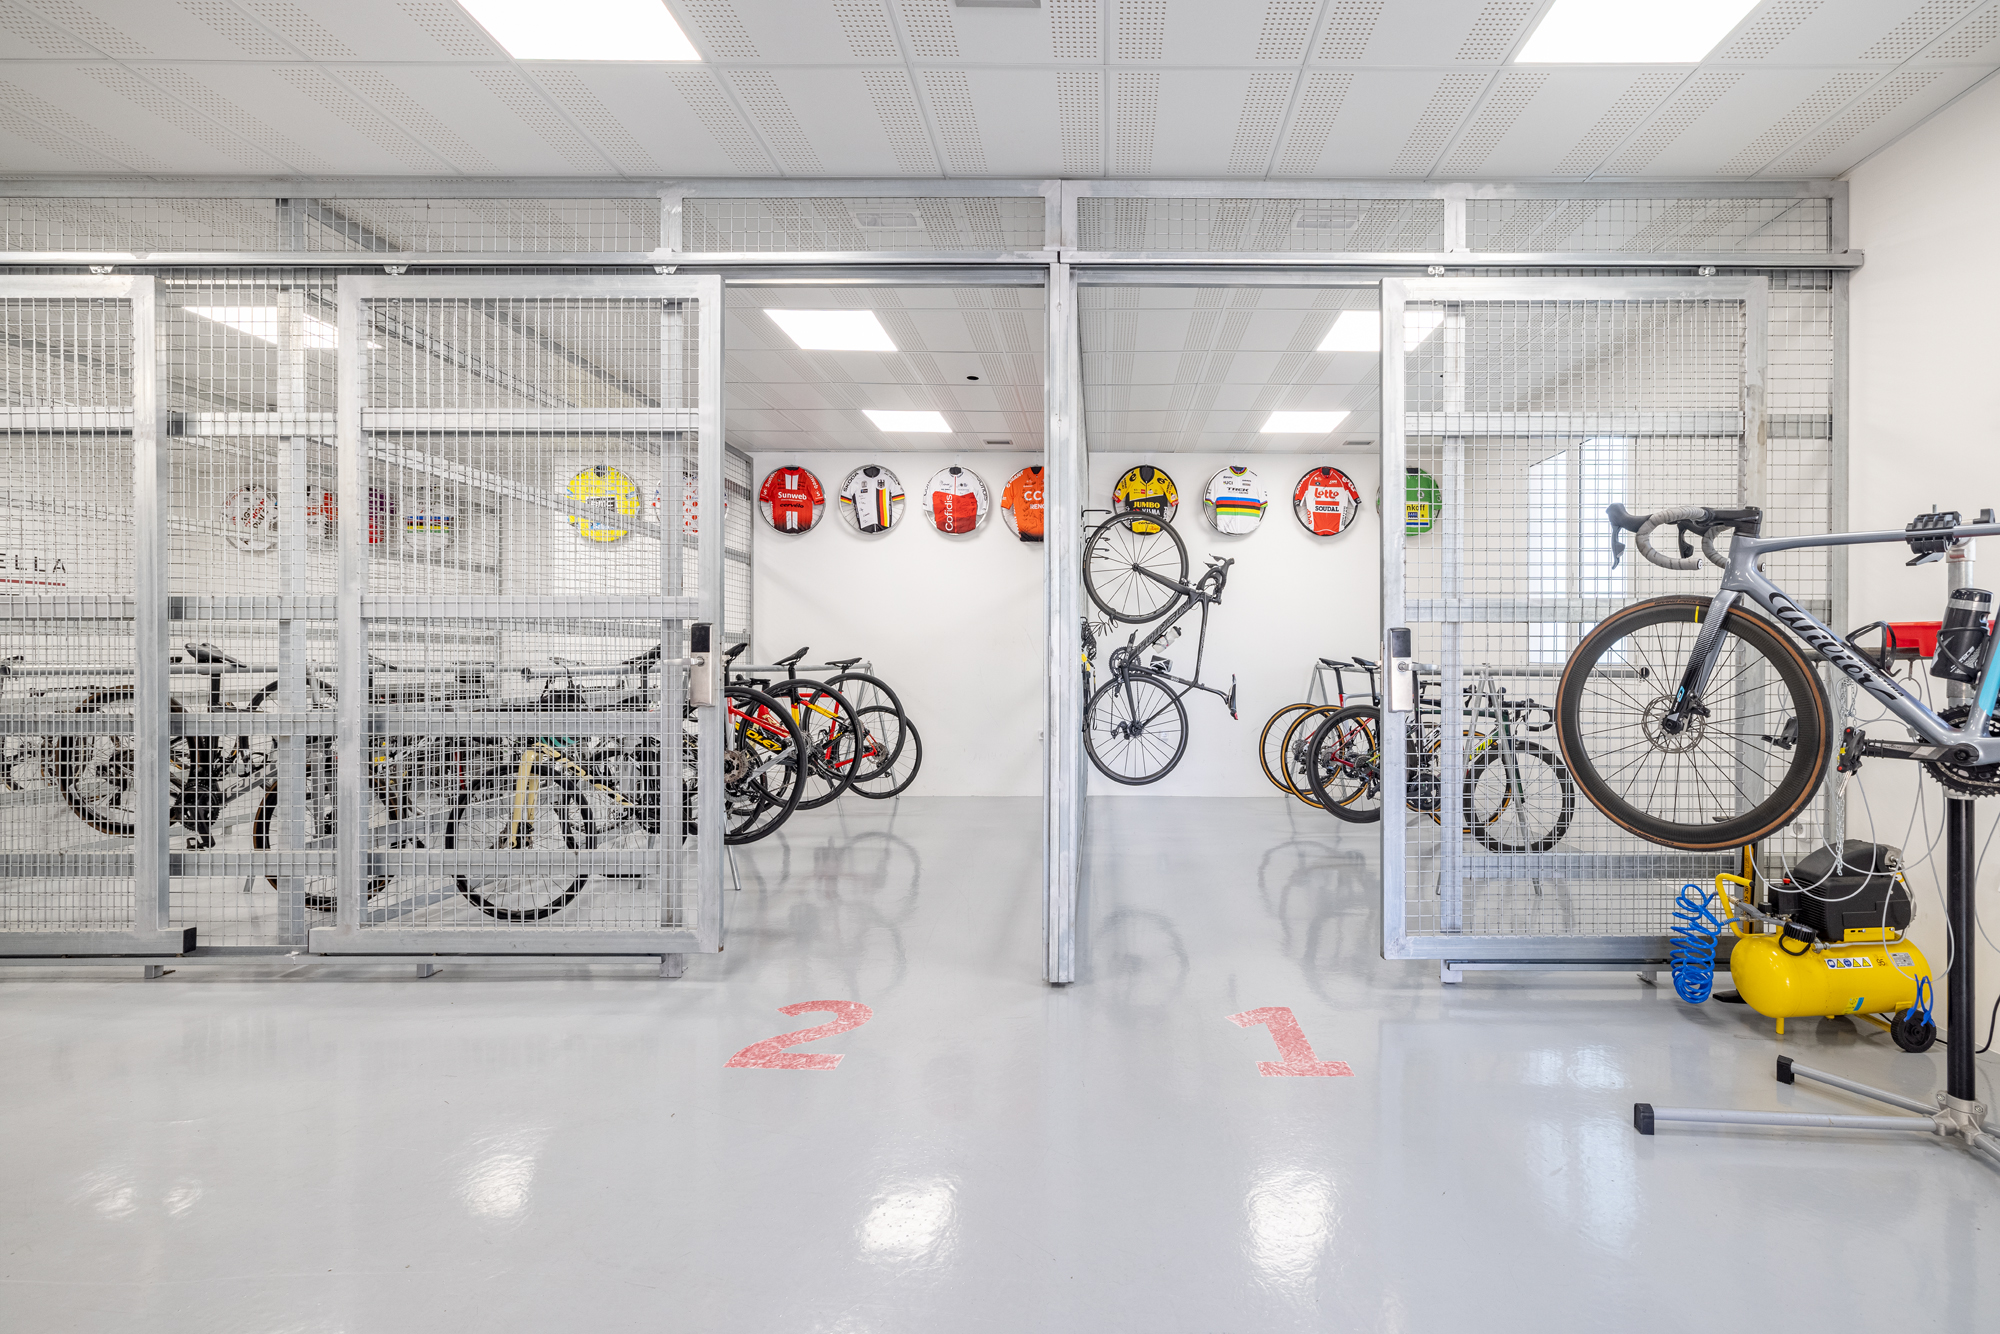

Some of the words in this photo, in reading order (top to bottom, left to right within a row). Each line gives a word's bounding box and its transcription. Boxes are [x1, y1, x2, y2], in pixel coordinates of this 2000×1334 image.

[777, 491, 808, 501] Sunweb
[943, 494, 954, 532] Cofidis
[1023, 490, 1045, 502] CC
[1132, 501, 1161, 509] JUMBO
[1768, 591, 1898, 701] Wilier
[723, 1000, 873, 1070] 2
[1224, 1006, 1355, 1077] 1
